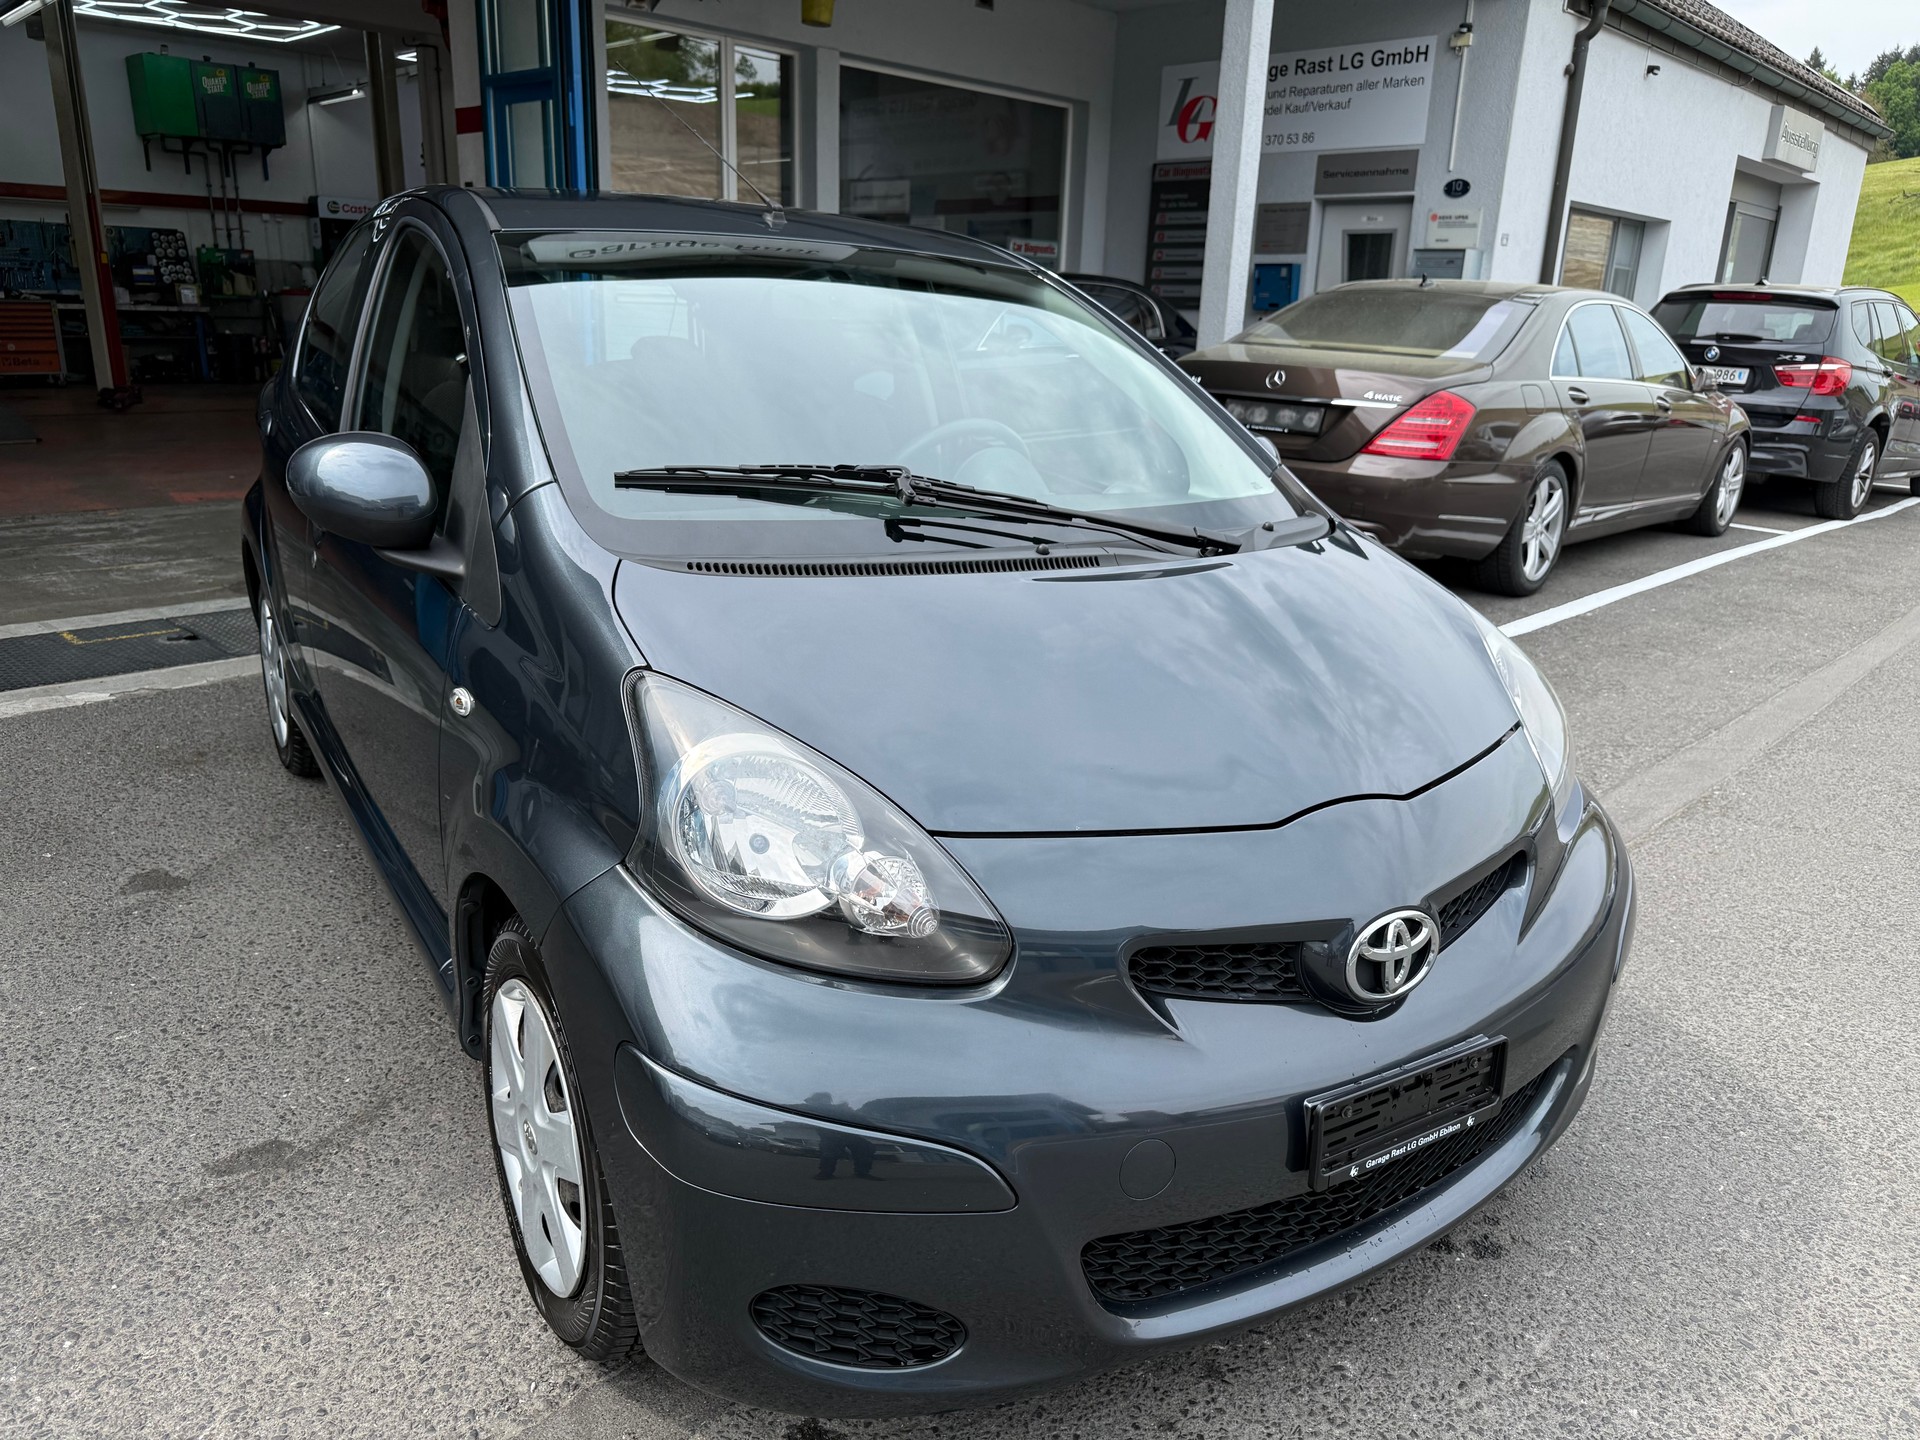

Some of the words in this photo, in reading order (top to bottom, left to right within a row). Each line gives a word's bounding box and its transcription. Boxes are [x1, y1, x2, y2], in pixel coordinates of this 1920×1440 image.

[1294, 56, 1334, 76] Rast
[1339, 52, 1364, 71] LG
[1371, 44, 1430, 67] GmbH
[1288, 82, 1353, 98] Reparaturen
[1356, 79, 1380, 91] aller
[1382, 75, 1425, 89] Marken
[1284, 98, 1352, 114] Kauf/Verkauf
[1264, 134, 1284, 146] 370
[1286, 133, 1299, 145] 53
[1301, 132, 1315, 143] 86
[1780, 119, 1819, 159] Ausstellung
[1322, 167, 1409, 180] Serviceannahme
[1452, 181, 1463, 192] 10
[1365, 1154, 1390, 1168] Garage
[1391, 1145, 1407, 1159] Rast
[1407, 1140, 1418, 1151] LG
[1418, 1132, 1438, 1145] GmbH
[1440, 1123, 1461, 1136] Ebikon
